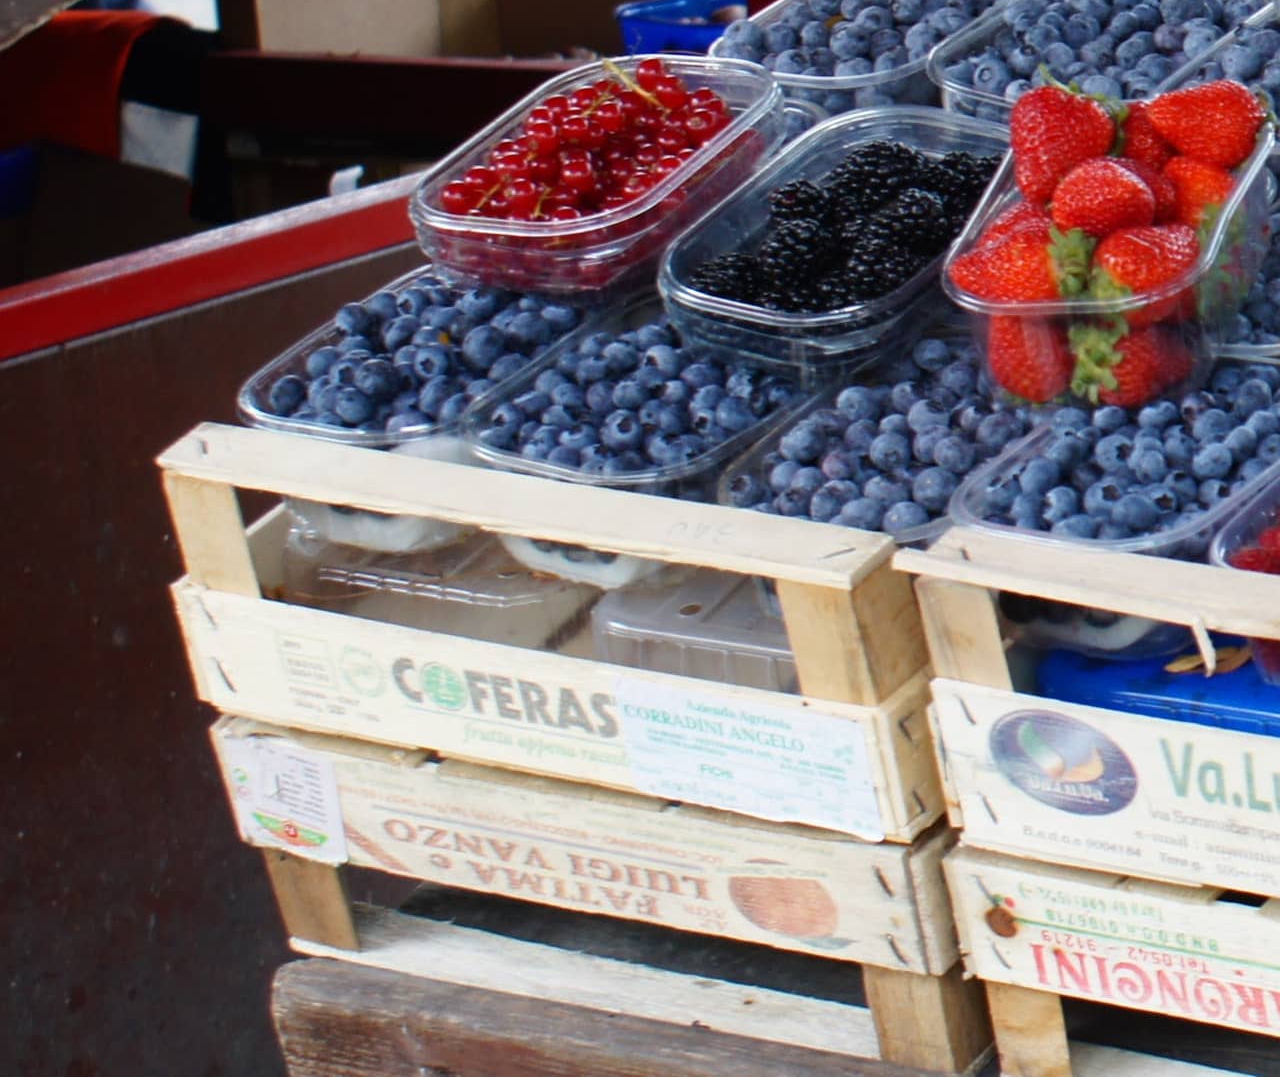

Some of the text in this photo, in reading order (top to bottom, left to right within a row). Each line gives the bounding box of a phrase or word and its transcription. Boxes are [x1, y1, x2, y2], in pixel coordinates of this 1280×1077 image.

[622, 703, 806, 754] CORRADINI ANGELO
[382, 818, 554, 872] VANZO
[466, 860, 661, 919] FATIMA
[567, 853, 710, 901] LUIGI
